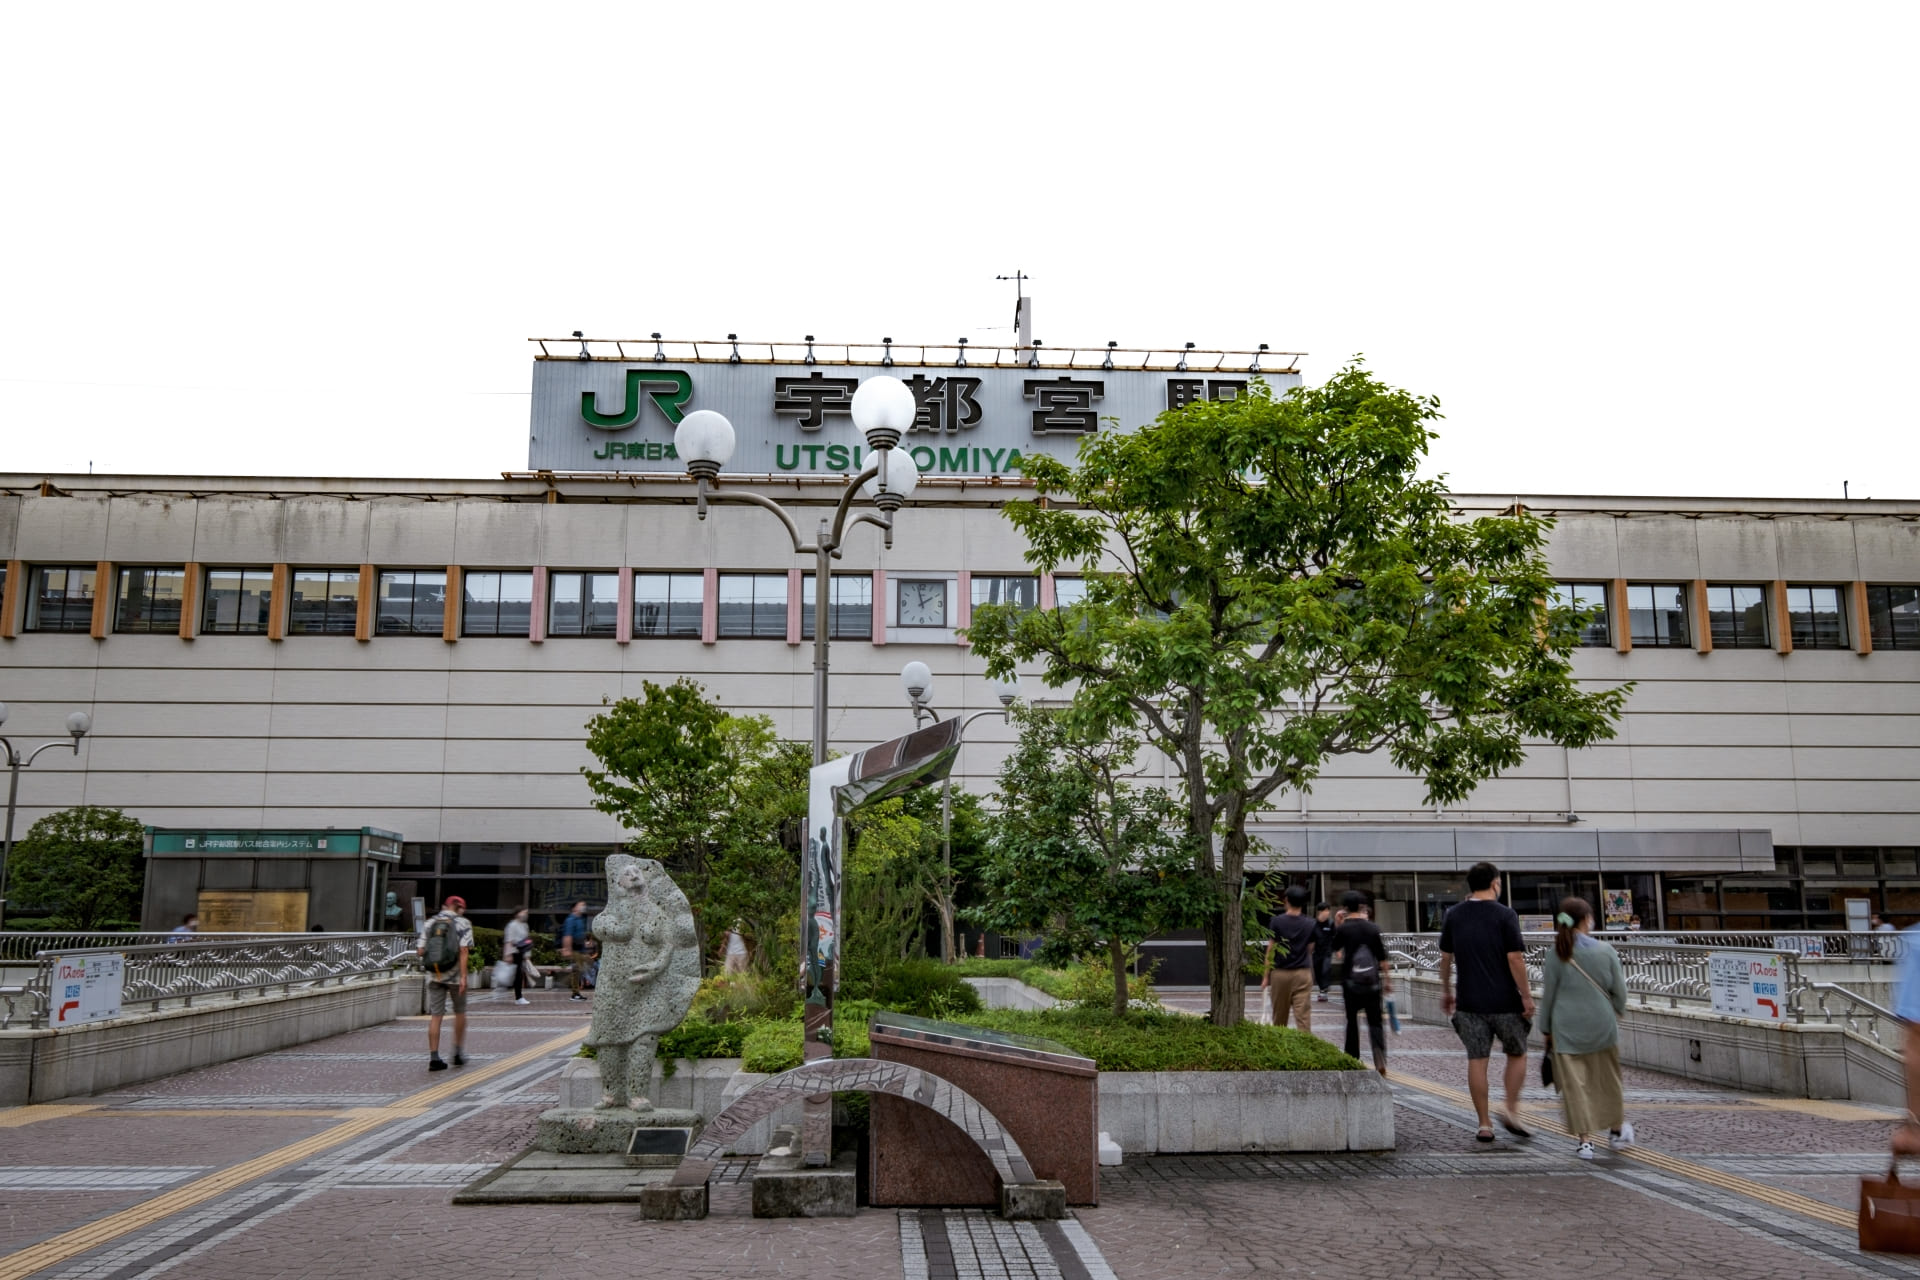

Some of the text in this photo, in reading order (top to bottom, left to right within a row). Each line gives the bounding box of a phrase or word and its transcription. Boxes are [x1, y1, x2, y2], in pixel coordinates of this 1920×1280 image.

[581, 369, 693, 431] JR
[594, 441, 680, 461] JR東日本
[776, 444, 1026, 473] UTSUOMIYA
[1749, 962, 1778, 977] バスのりば
